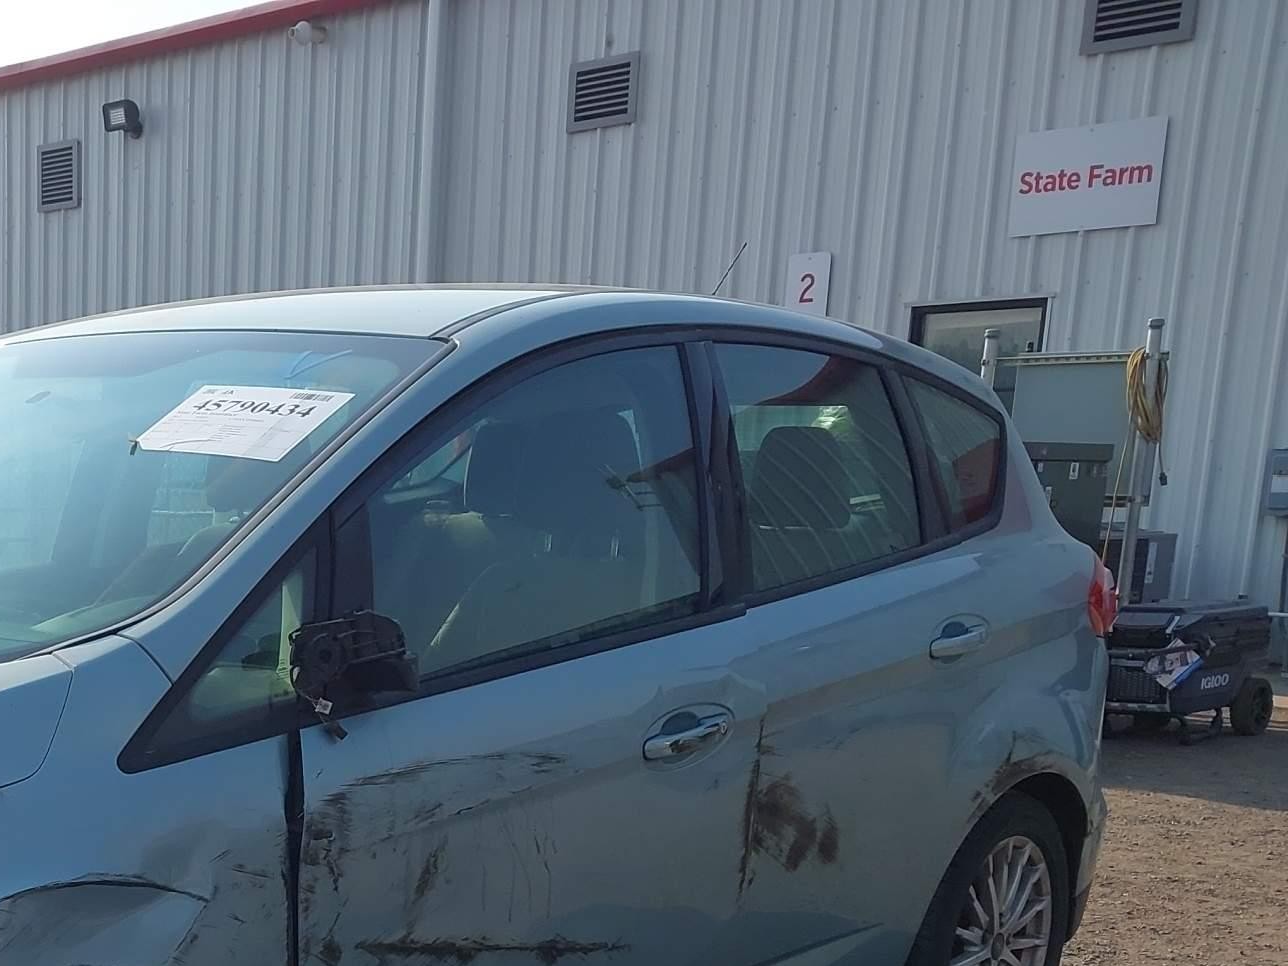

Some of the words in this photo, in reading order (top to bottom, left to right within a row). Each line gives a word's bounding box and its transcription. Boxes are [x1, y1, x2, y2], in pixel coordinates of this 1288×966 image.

[1018, 168, 1081, 194] State
[1088, 164, 1153, 188] Farm
[799, 273, 815, 303] 2
[192, 399, 316, 418] 45790434
[1200, 673, 1230, 690] IGLOO
